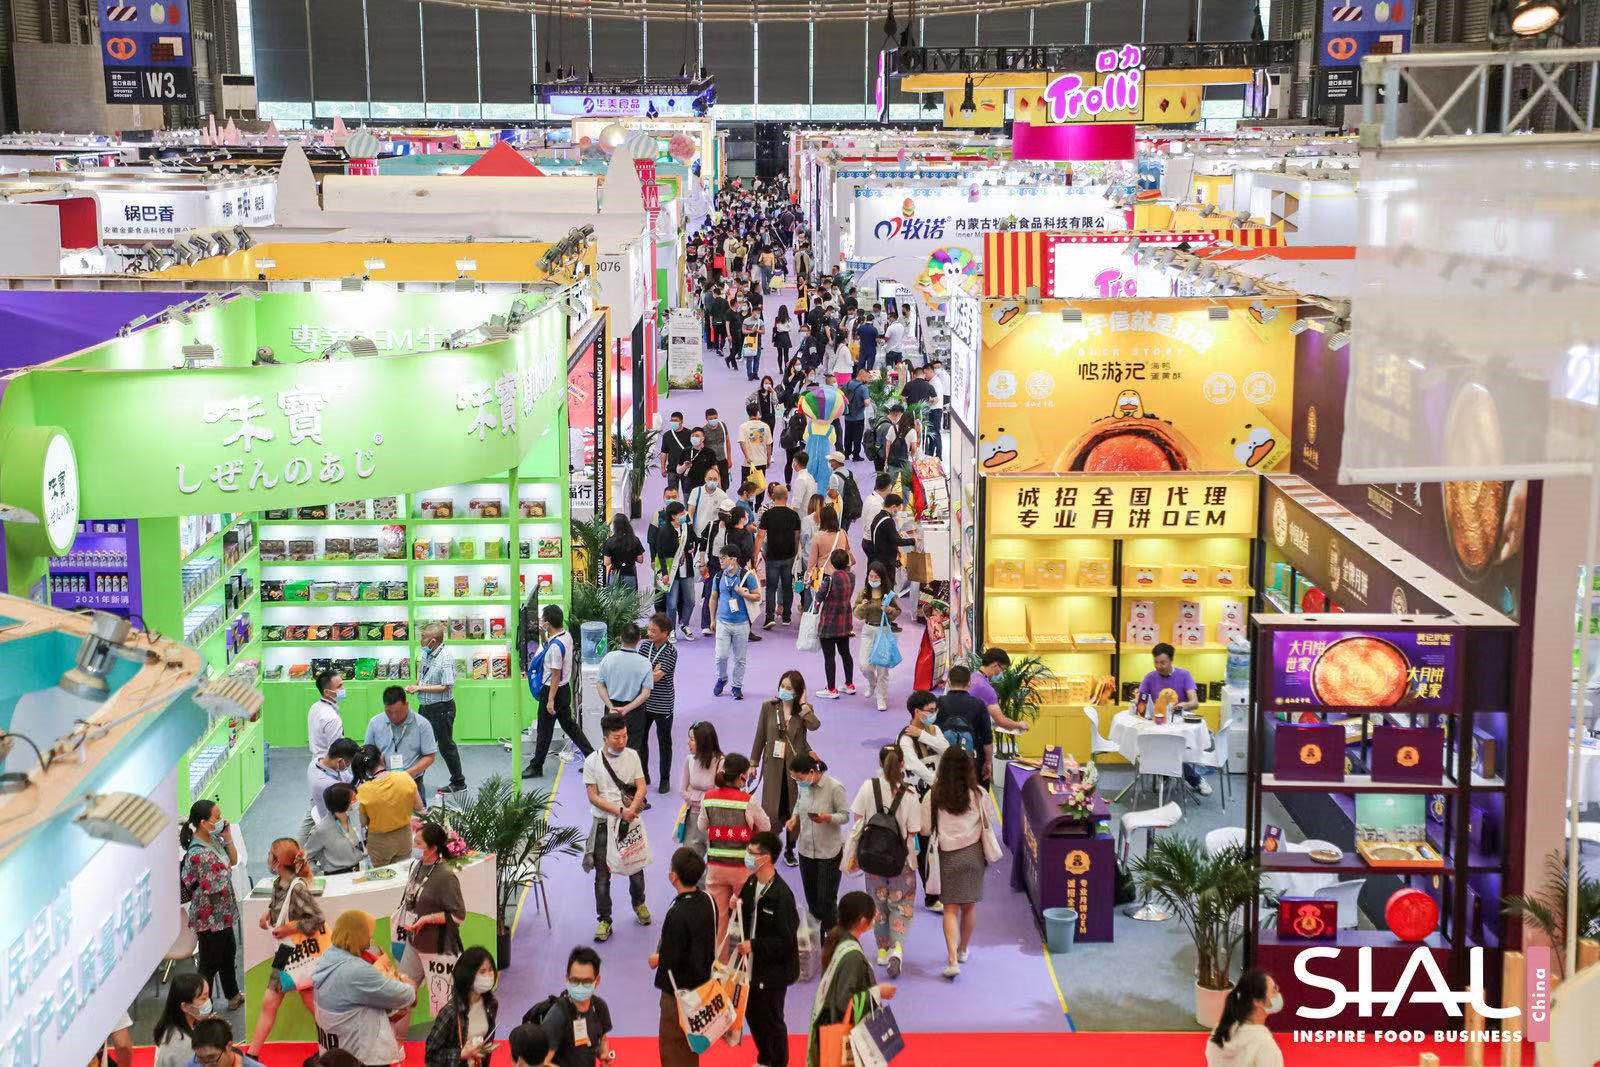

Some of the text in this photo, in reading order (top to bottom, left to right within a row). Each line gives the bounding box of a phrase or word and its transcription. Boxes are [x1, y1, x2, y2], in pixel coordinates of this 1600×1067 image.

[146, 72, 175, 98] W3
[597, 98, 640, 108] 华美食品
[1044, 69, 1140, 123] Trolli
[125, 204, 174, 222] 锅巴香
[901, 217, 947, 240] 牧诺
[176, 448, 376, 495] しぜんのあじ
[1017, 486, 1227, 508] 诚招全国代理
[1288, 640, 1327, 657] 大月饼
[1285, 657, 1312, 673] 世家
[1407, 666, 1445, 683] 大月饼
